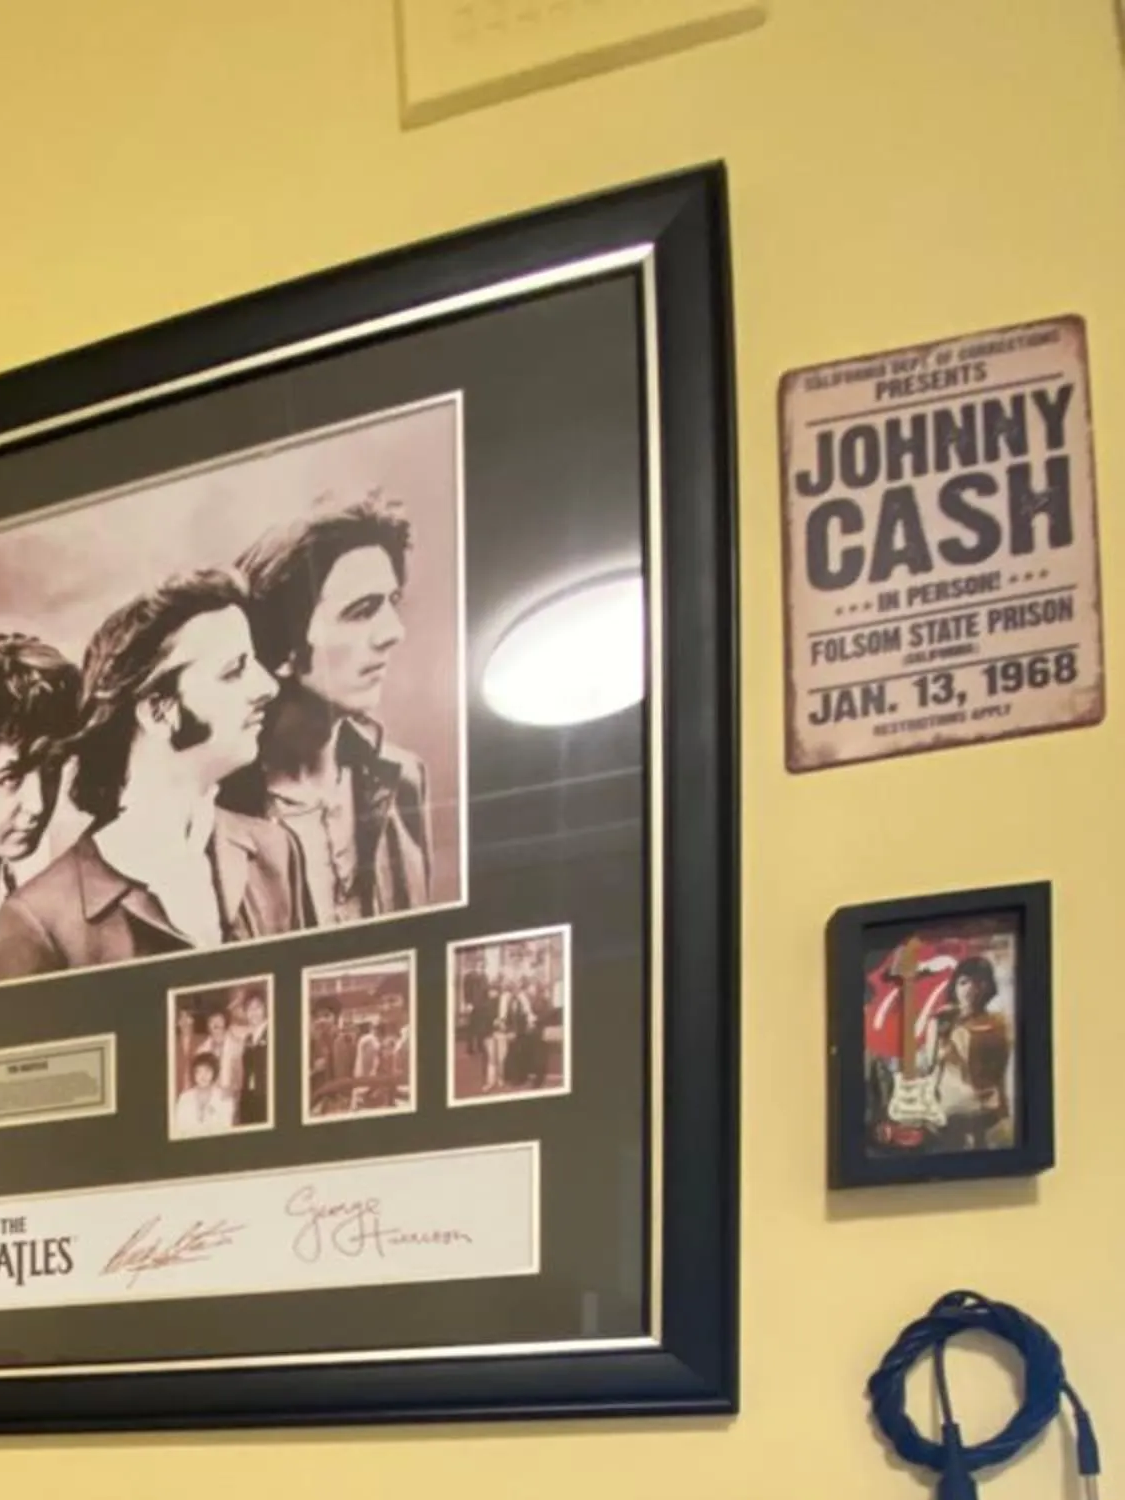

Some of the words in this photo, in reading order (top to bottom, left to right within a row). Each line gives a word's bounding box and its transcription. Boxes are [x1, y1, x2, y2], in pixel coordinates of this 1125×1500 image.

[875, 361, 988, 401] PRESENTS
[795, 384, 1074, 497] JOHNNY
[806, 455, 1073, 591] CASH
[877, 589, 900, 613] IN
[907, 570, 1001, 607] PERSON!
[810, 627, 901, 666] FOLSOM
[908, 612, 980, 648] STATE
[987, 596, 1074, 636] PRISON
[808, 683, 898, 725] JAN.
[912, 671, 967, 708] 13,
[982, 652, 1077, 697] 1968
[0, 1216, 27, 1236] THE
